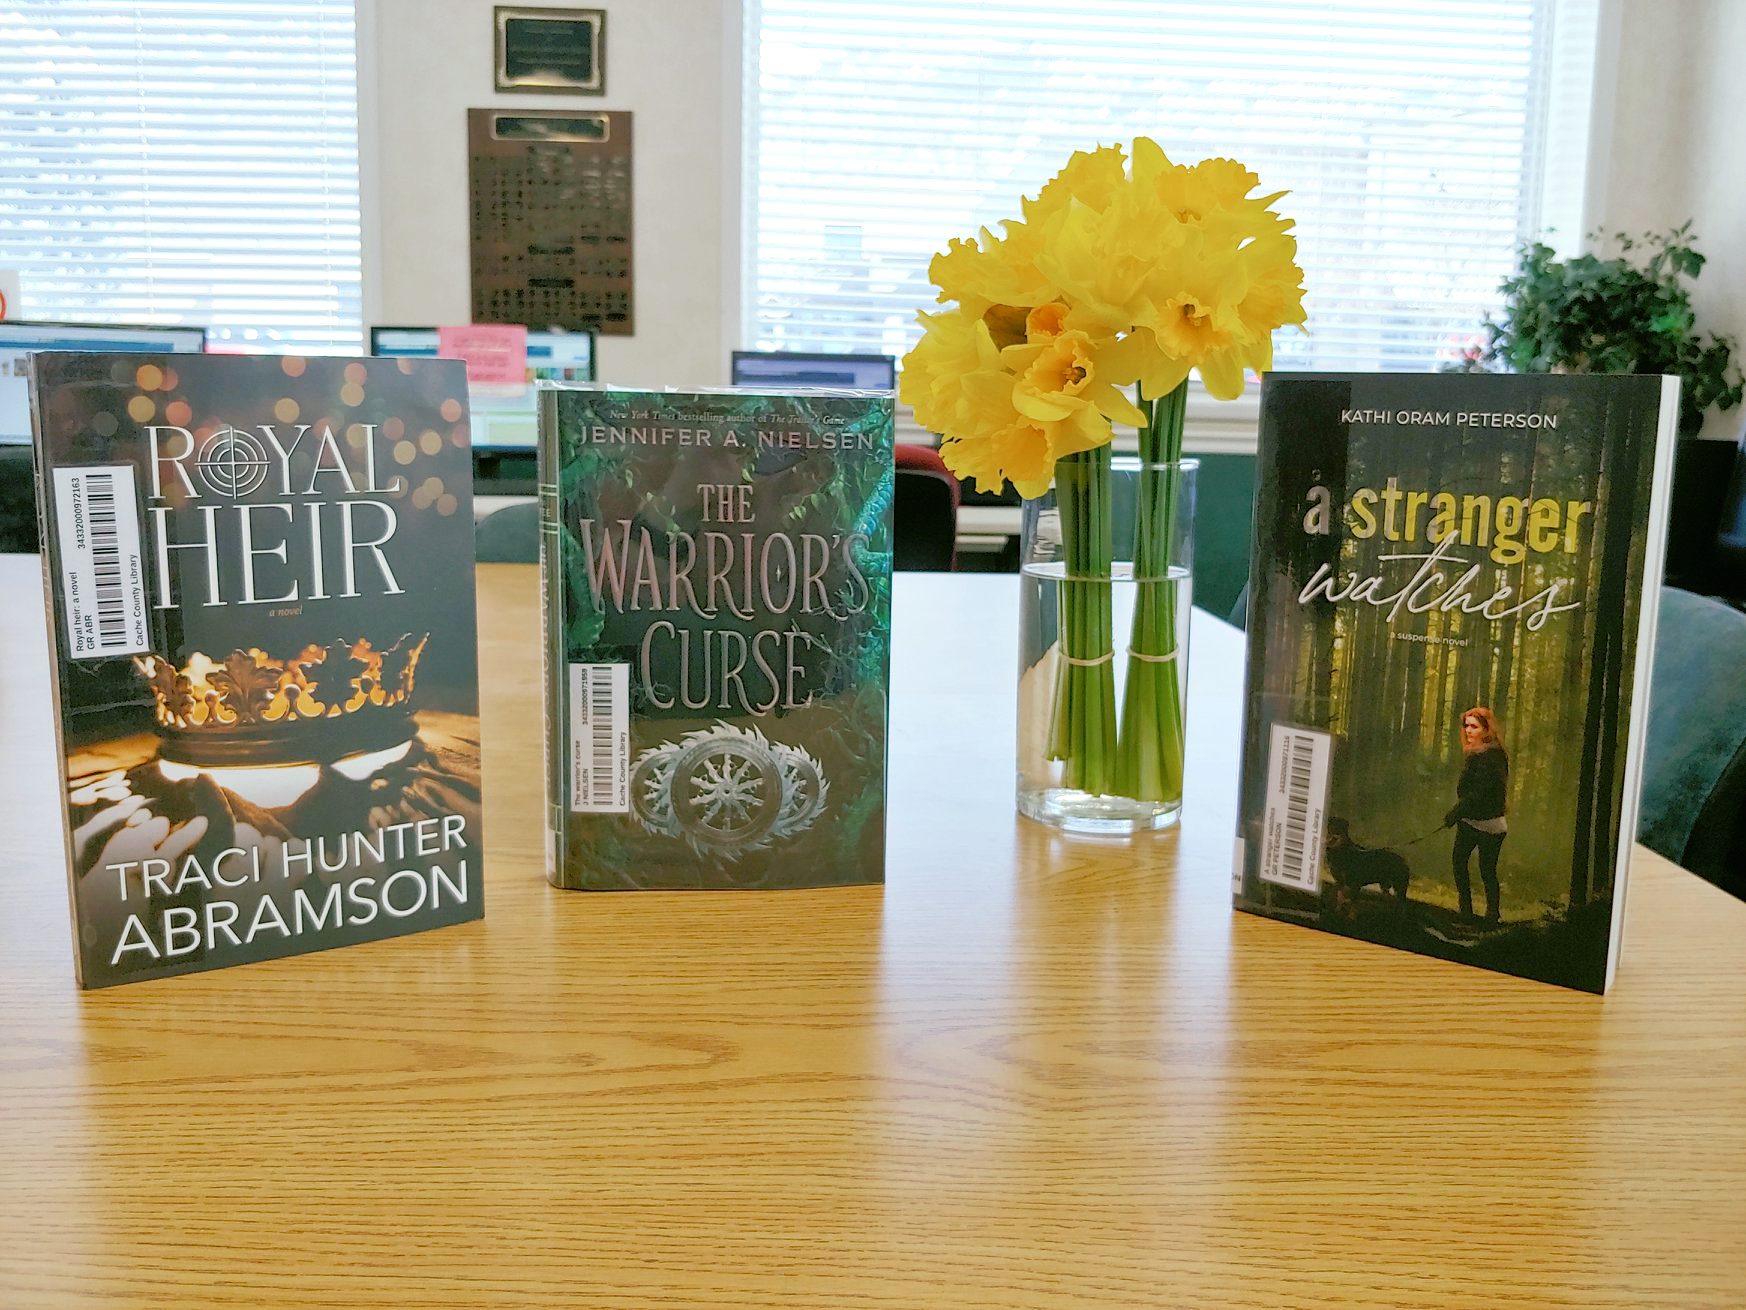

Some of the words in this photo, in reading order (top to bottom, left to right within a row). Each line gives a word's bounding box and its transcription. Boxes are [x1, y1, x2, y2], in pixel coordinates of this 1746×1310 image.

[610, 410, 627, 419] New
[631, 410, 649, 419] York
[653, 410, 675, 420] Times
[678, 412, 725, 424] bestselling
[726, 413, 756, 423] author
[758, 414, 768, 423] of
[770, 414, 786, 424] The
[822, 415, 845, 425] Game
[1340, 409, 1391, 424] KATHI
[1396, 411, 1450, 426] ORAM
[1456, 412, 1558, 429] PETERSON
[580, 426, 712, 447] JENNIFER
[723, 431, 746, 447] A.
[758, 430, 874, 450] NIELSEN
[144, 424, 401, 500] ROYAL
[72, 477, 86, 549] 34332000972163
[697, 484, 755, 523] THE
[1303, 484, 1331, 535] a
[1351, 477, 1591, 565] stranger
[148, 500, 405, 609] HEIR
[69, 571, 79, 596] novel
[129, 554, 138, 585] Library
[579, 519, 870, 621] WARRIOR'S
[1298, 529, 1581, 631] watches
[73, 606, 82, 625] heir:
[133, 588, 142, 617] County
[278, 603, 303, 616] novel
[85, 614, 93, 633] ABR
[135, 618, 144, 646] Cache
[73, 625, 85, 652] Royal
[87, 635, 95, 650] GR
[1397, 632, 1441, 646] suspense
[1443, 635, 1468, 647] novel
[641, 620, 812, 716] CURSE
[1312, 808, 1321, 834] Library
[1272, 823, 1282, 863] PETERSON
[1310, 836, 1319, 861] County
[105, 846, 260, 901] TRACI
[281, 814, 468, 878] HUNTER
[1307, 861, 1315, 885] Cache
[111, 860, 468, 965] ABRAMSON
